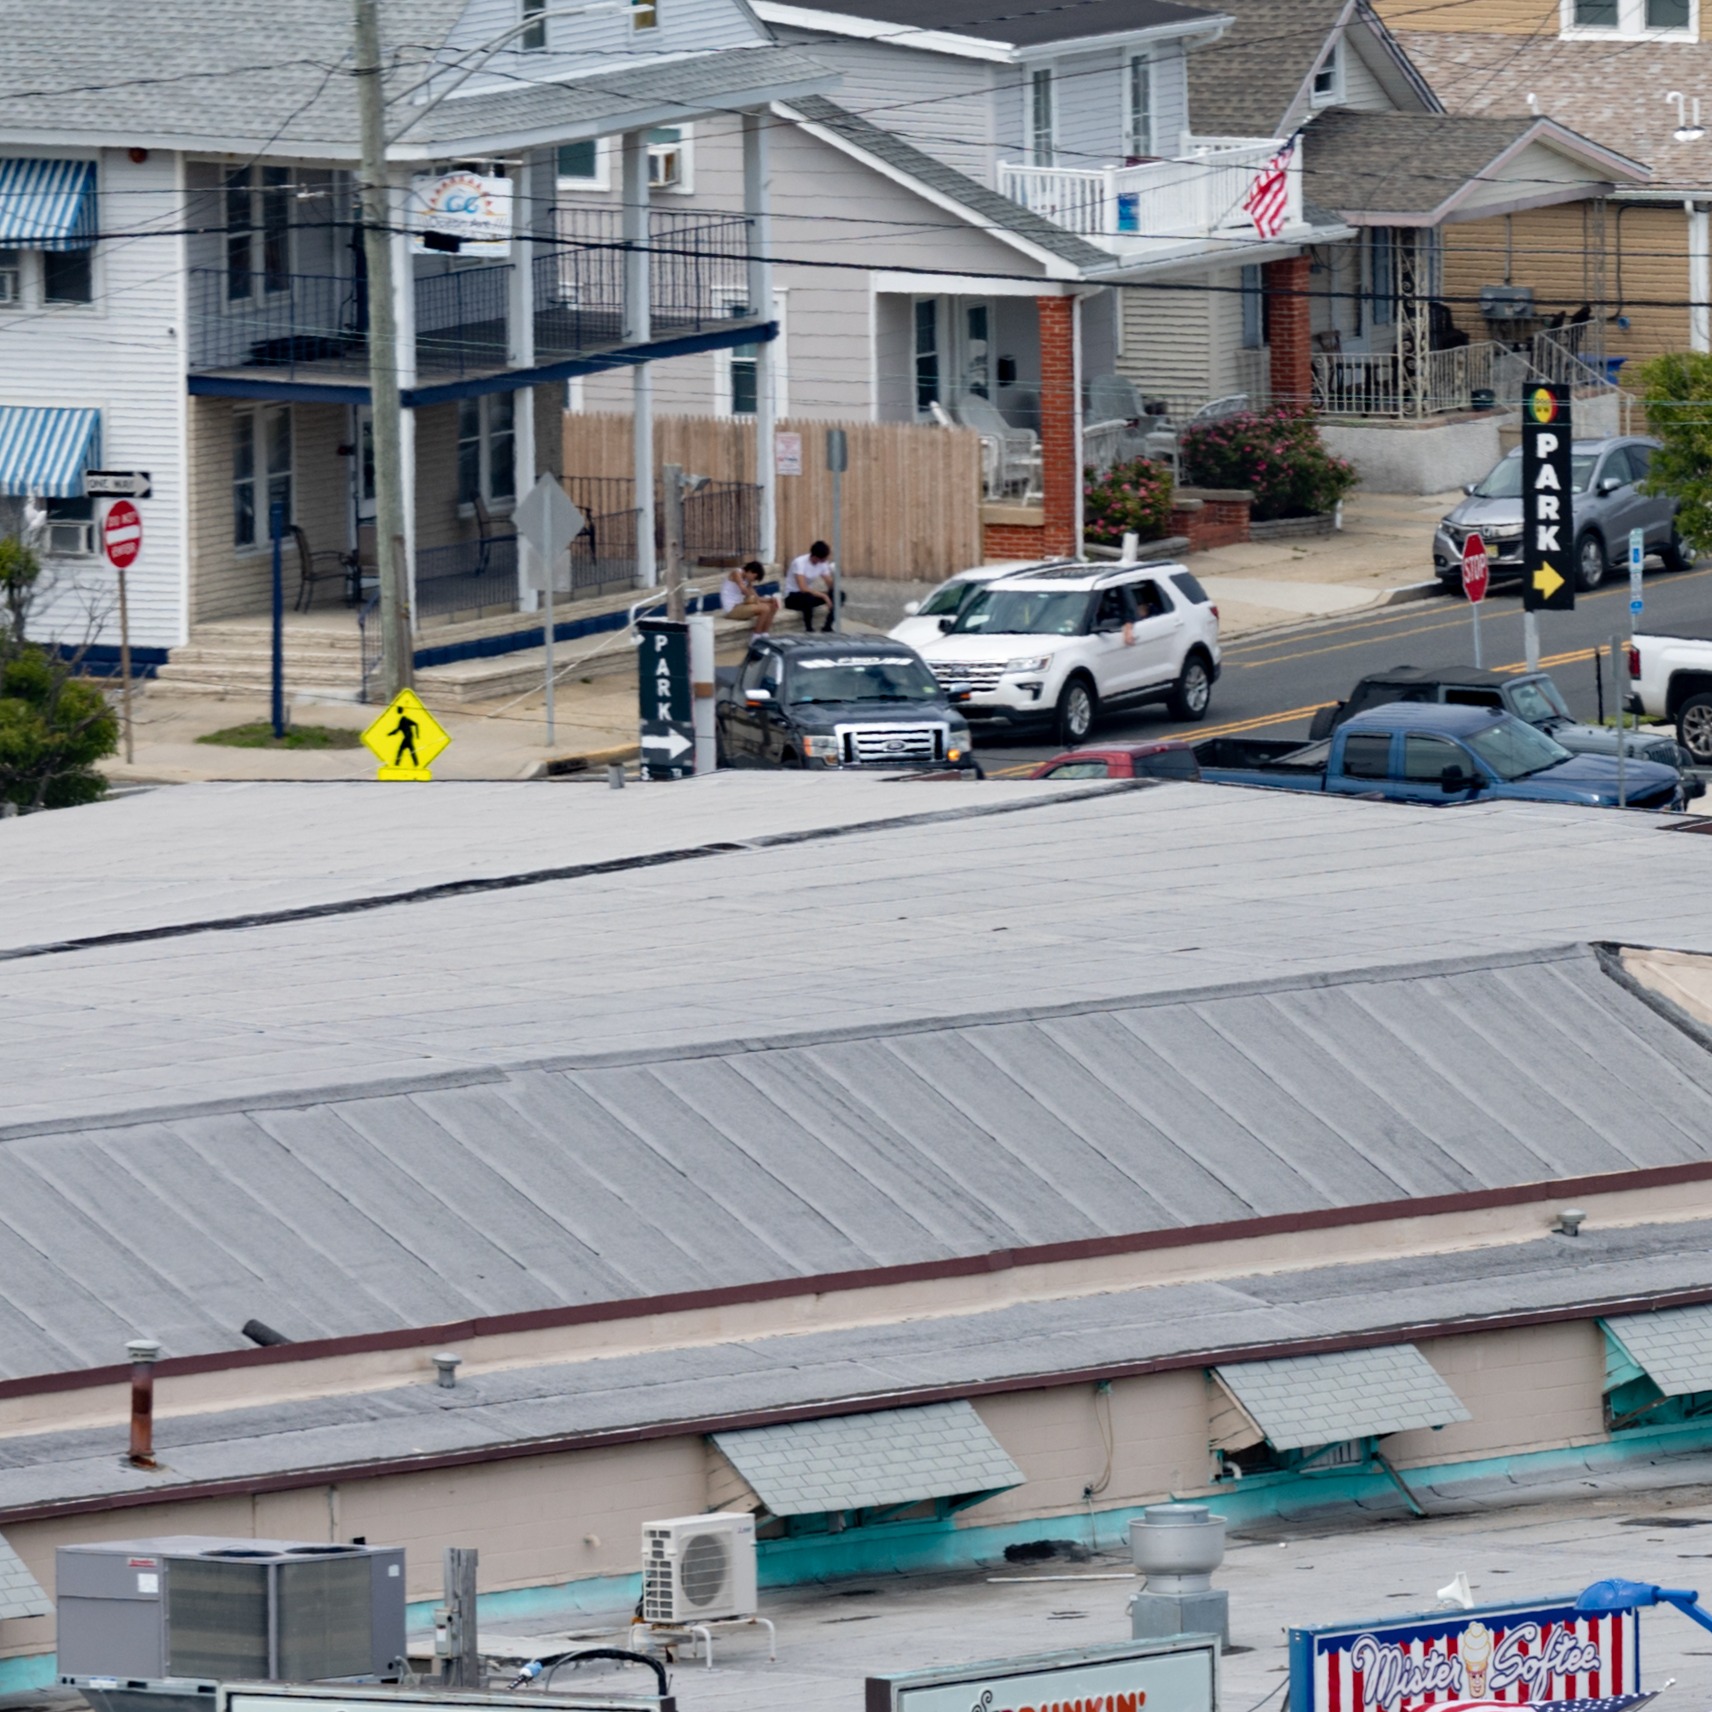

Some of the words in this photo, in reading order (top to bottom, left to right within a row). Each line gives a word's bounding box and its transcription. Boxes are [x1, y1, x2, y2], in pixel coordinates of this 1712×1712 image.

[1535, 433, 1562, 551] PARK
[1463, 554, 1486, 582] STOP
[654, 634, 672, 721] PARK
[1352, 1633, 1463, 1711] Mister
[1489, 1621, 1602, 1702] Softee
